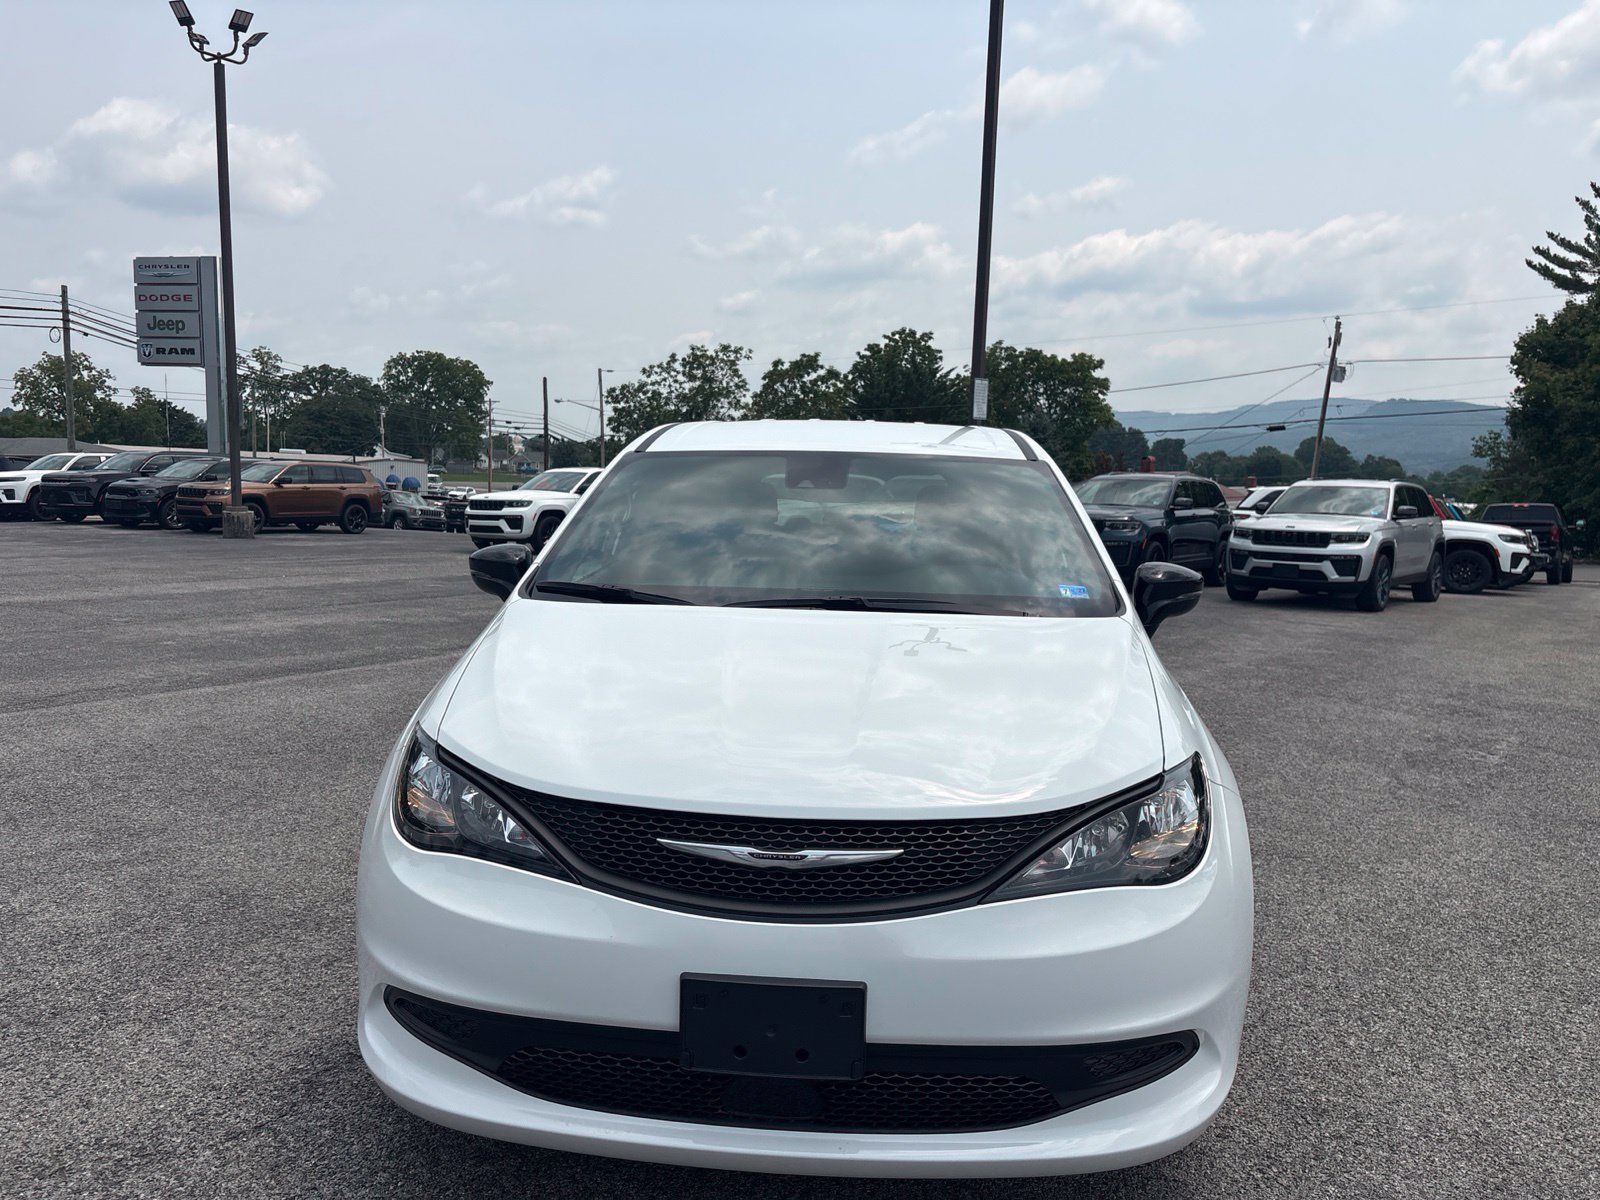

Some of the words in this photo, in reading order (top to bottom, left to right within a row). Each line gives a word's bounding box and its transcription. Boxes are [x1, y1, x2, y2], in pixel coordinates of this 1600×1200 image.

[138, 294, 193, 302] DODGE
[147, 315, 186, 334] Jeep
[155, 347, 196, 355] RAM
